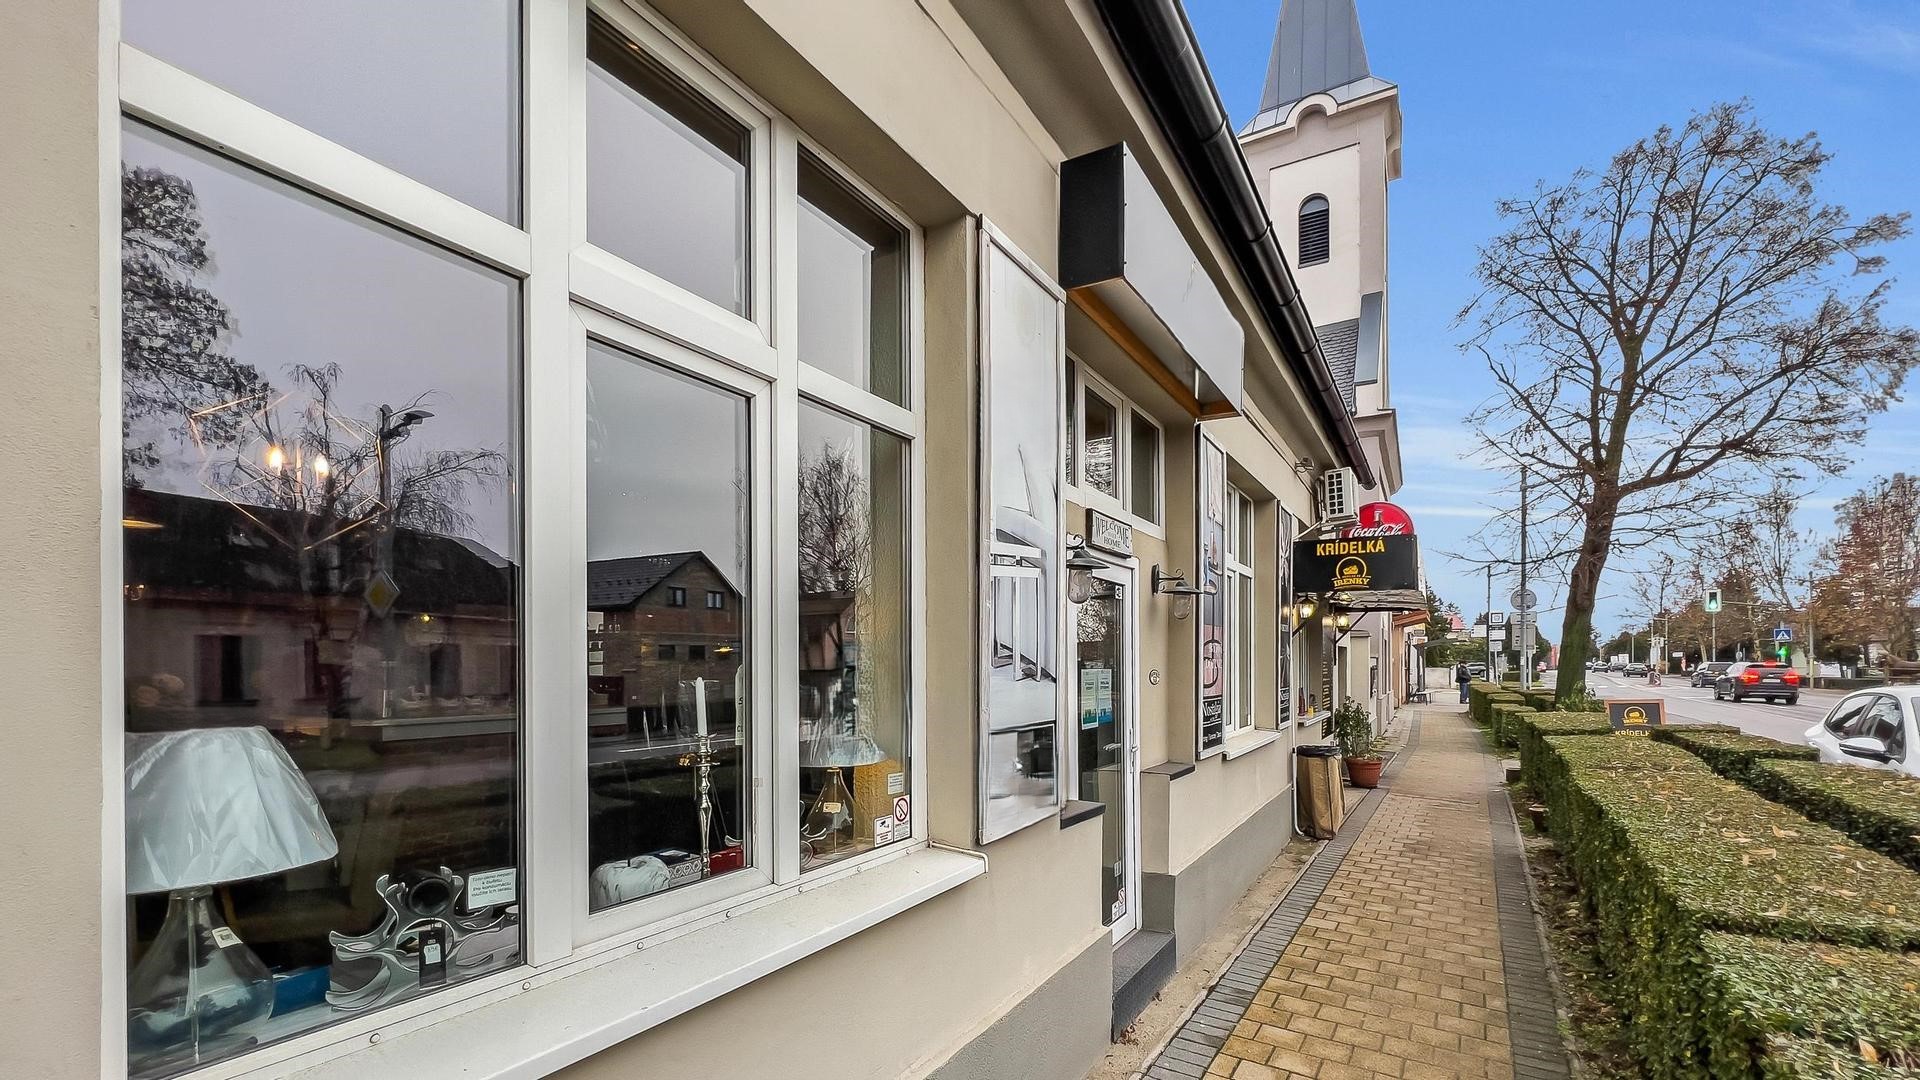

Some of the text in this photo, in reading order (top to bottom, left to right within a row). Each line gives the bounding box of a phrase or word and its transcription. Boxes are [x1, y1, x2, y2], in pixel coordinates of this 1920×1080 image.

[1095, 516, 1129, 549] WELCOME
[1104, 536, 1121, 548] HOME
[1316, 537, 1385, 556] KRÍDELKÁ
[1615, 729, 1651, 737] KRÍDELK
